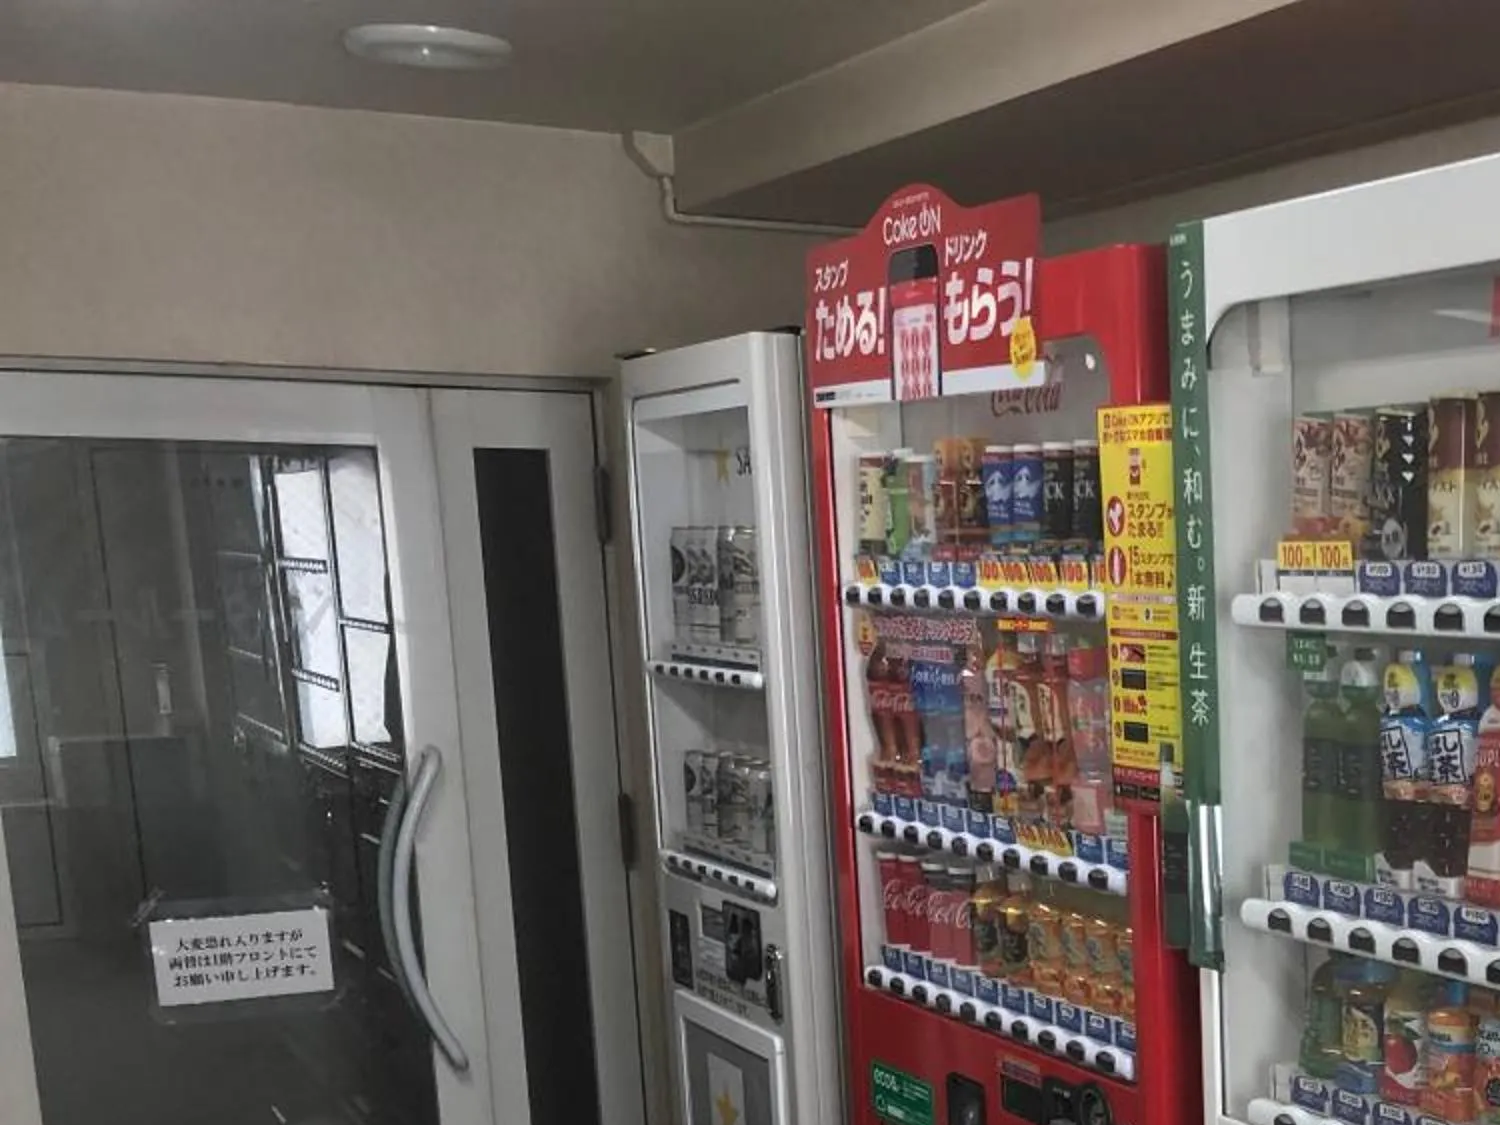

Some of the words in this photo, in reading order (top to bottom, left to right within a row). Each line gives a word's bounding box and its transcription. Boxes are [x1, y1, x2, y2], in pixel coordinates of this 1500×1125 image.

[883, 215, 918, 246] Coke
[920, 204, 941, 236] ON
[944, 228, 988, 267] ドリンク
[814, 259, 849, 292] スタンプ
[944, 257, 1034, 346] もらう!
[815, 286, 887, 362] ためる!
[1180, 260, 1207, 572] うまみに、和む。
[1187, 583, 1209, 727] 新生茶
[168, 944, 317, 970] 両替は1階フロントにて
[176, 928, 303, 953] 大変恐れ入りますが
[173, 964, 317, 989] お願い申し上げます。
